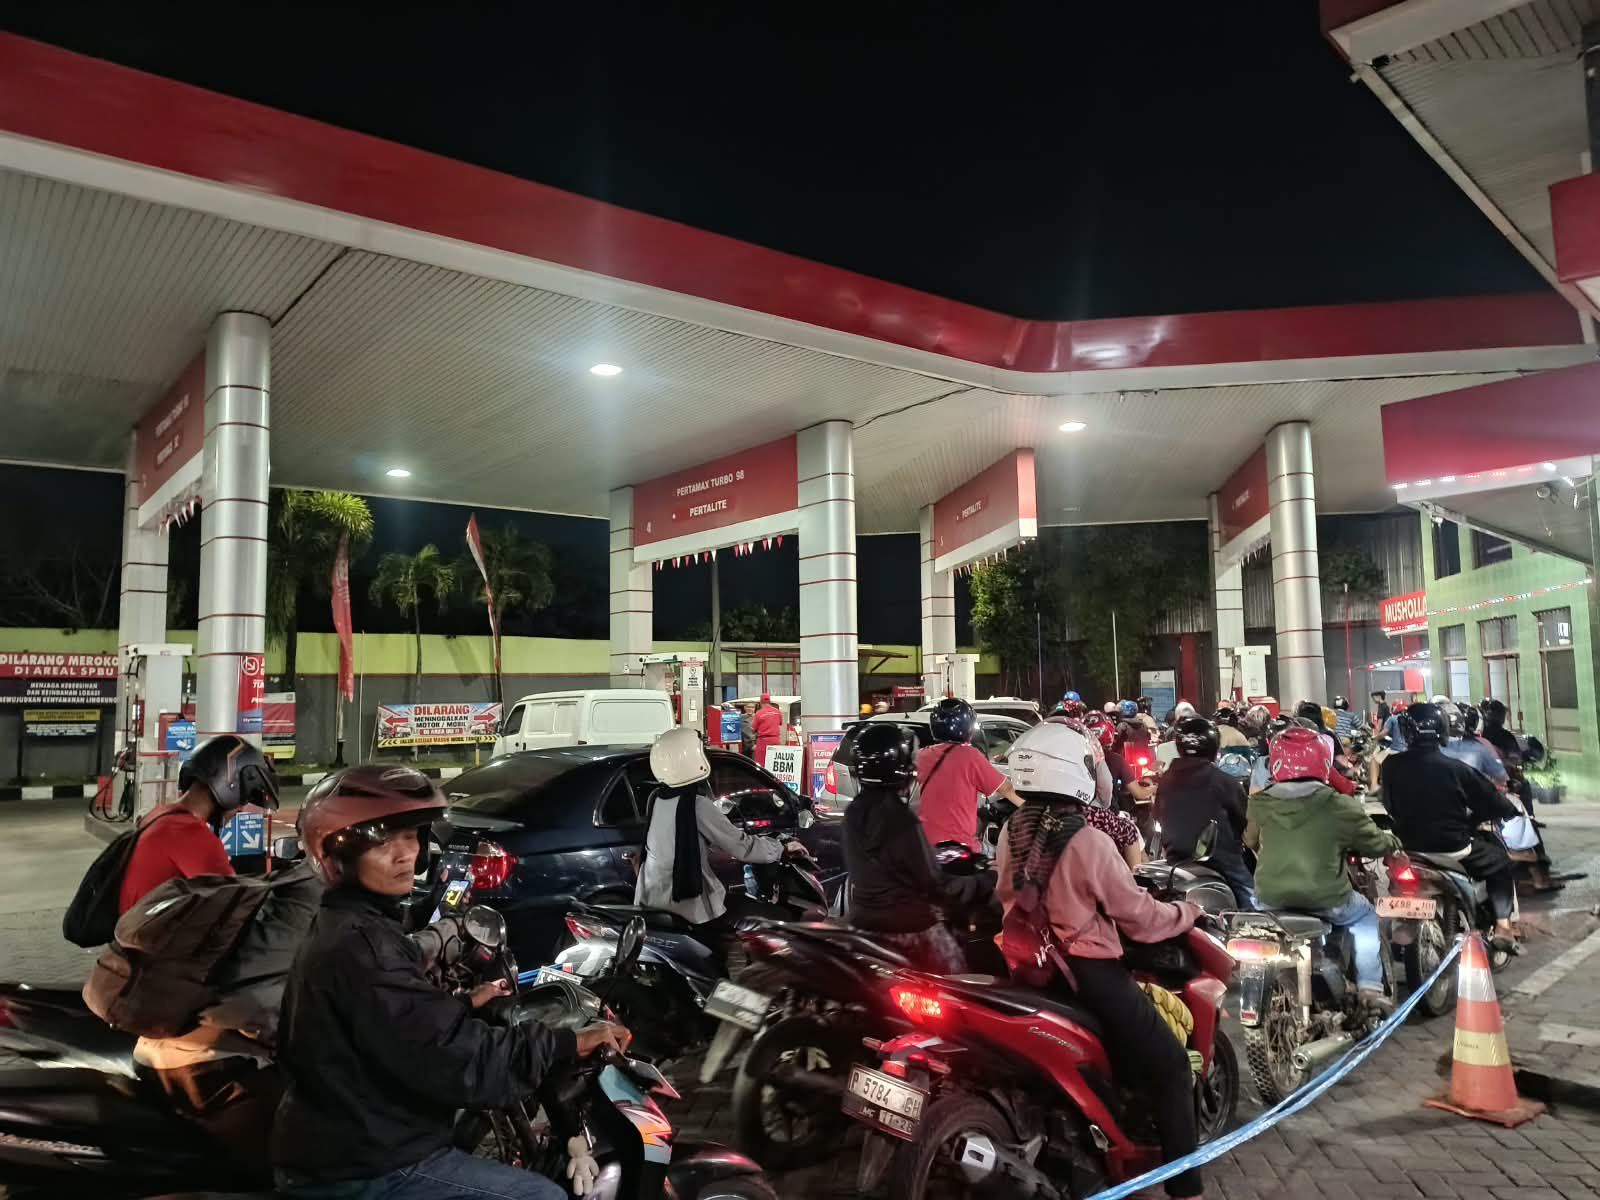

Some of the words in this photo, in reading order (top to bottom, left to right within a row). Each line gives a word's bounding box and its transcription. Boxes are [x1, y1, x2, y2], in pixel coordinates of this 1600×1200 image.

[676, 480, 710, 497] PERTAMAX
[711, 473, 733, 488] TURBO
[736, 470, 745, 481] 98
[689, 499, 727, 517] PERTALITE
[1385, 595, 1428, 624] MUSHOLLA
[0, 654, 65, 665] DILARANG
[14, 666, 29, 675] DI
[33, 667, 77, 675] AREAL
[80, 667, 114, 676] SPBU
[414, 705, 470, 716] DILARANG
[774, 751, 795, 761] JALUR
[773, 761, 794, 773] BBM
[1075, 789, 1091, 801] NASA
[852, 1071, 860, 1088] P
[863, 1077, 892, 1105] 5784
